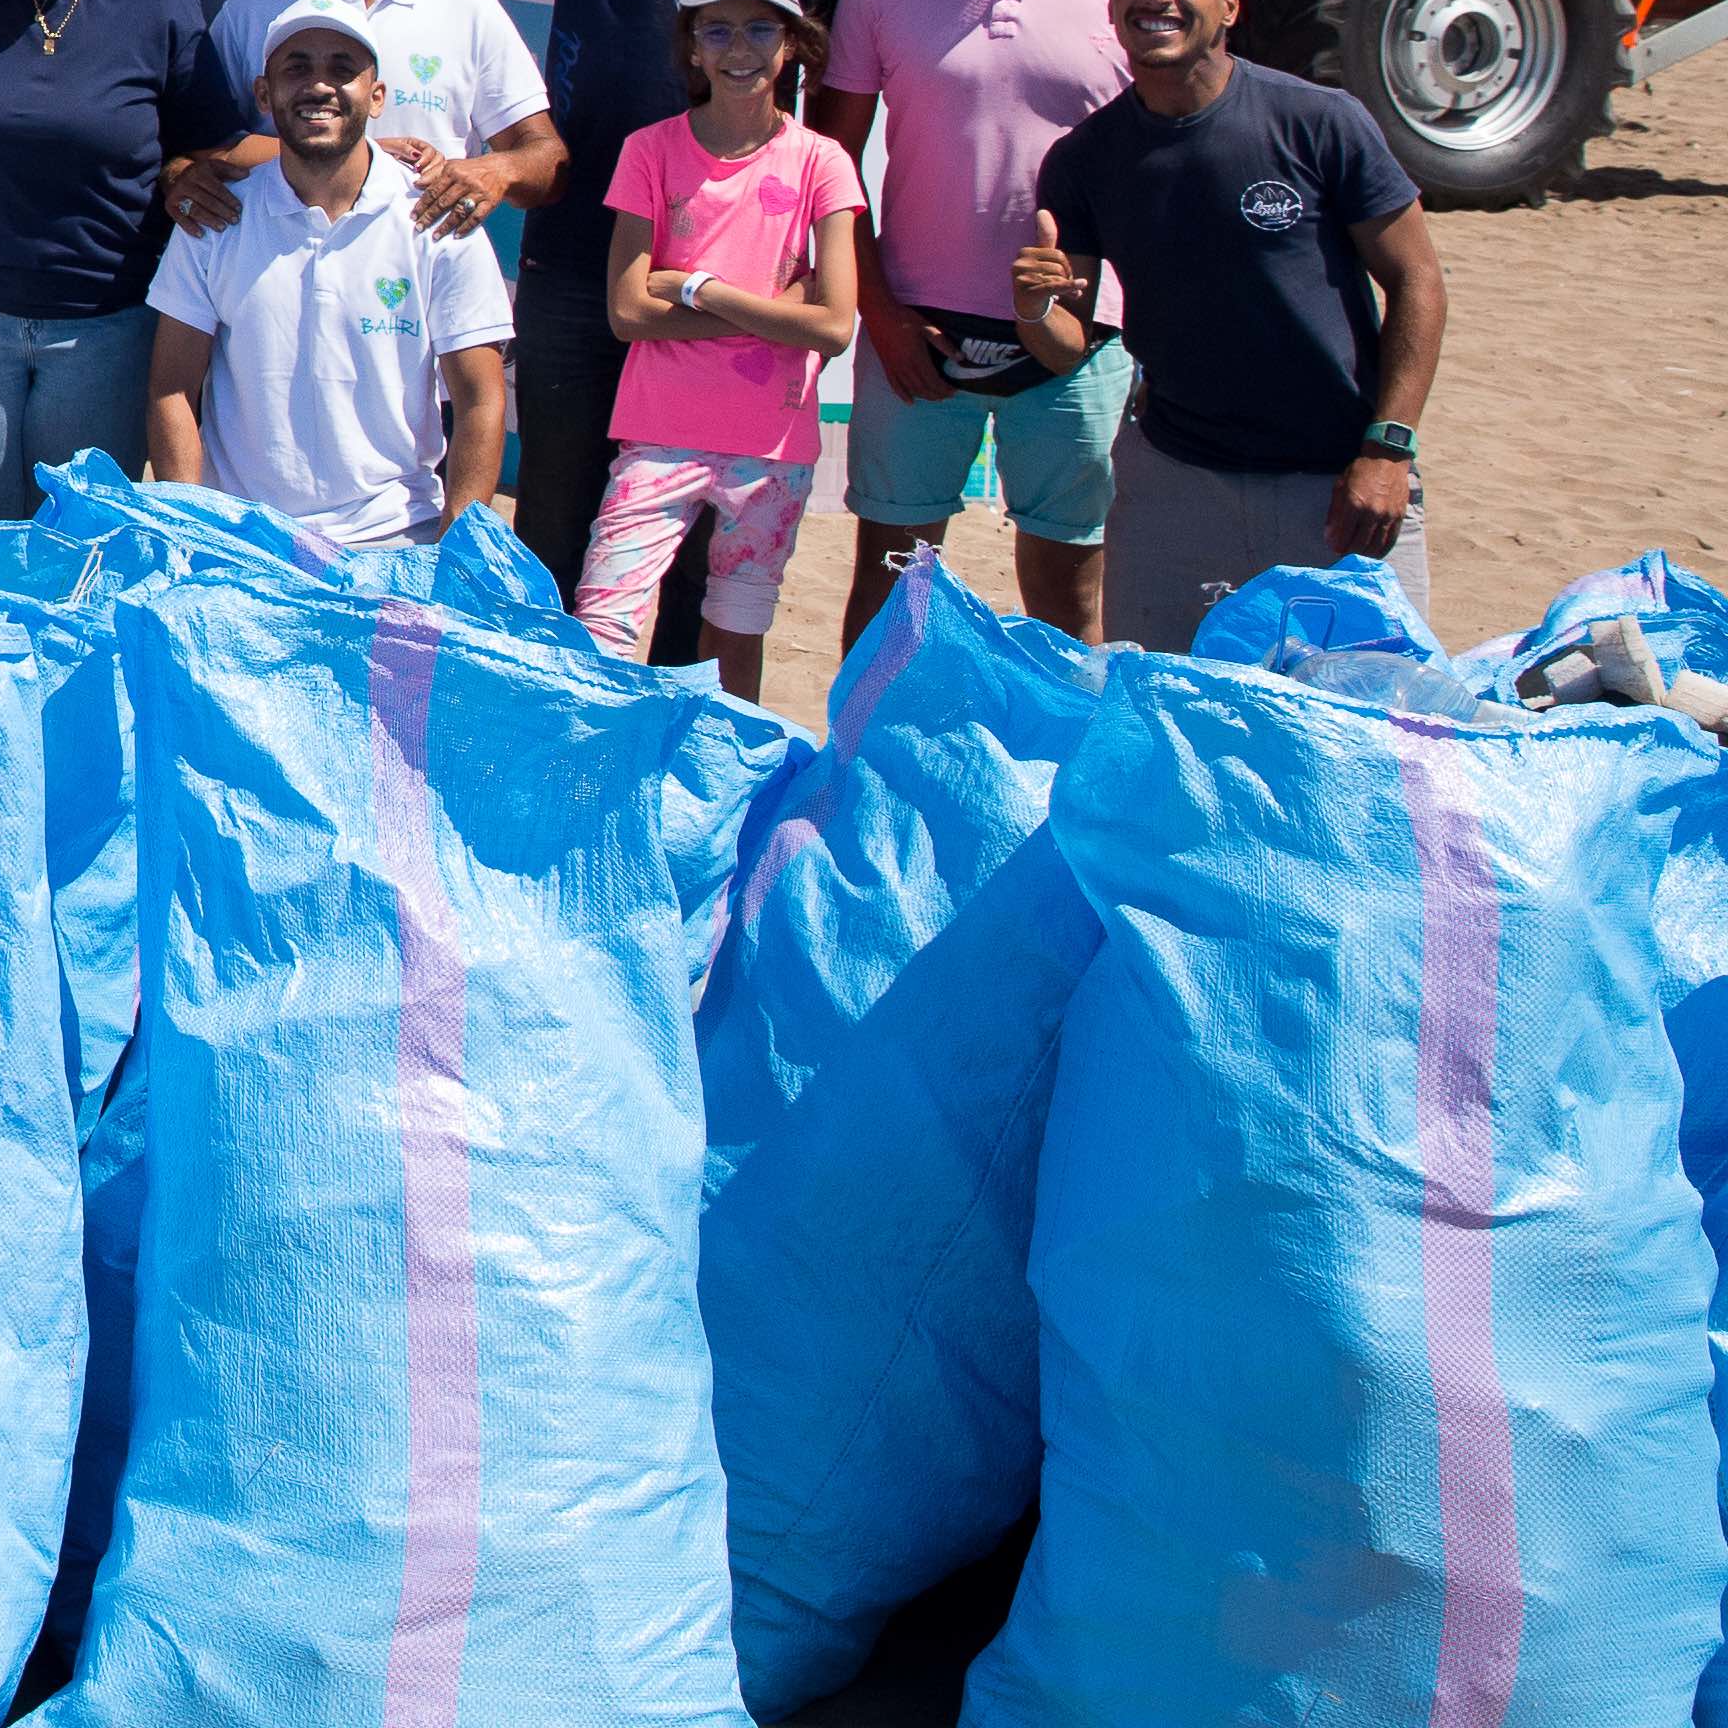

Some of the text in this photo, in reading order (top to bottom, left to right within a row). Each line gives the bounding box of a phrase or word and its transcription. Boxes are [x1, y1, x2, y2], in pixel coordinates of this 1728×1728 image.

[394, 88, 448, 113] BAHRI
[359, 315, 420, 337] BAHRI
[961, 337, 1021, 364] NIKE
